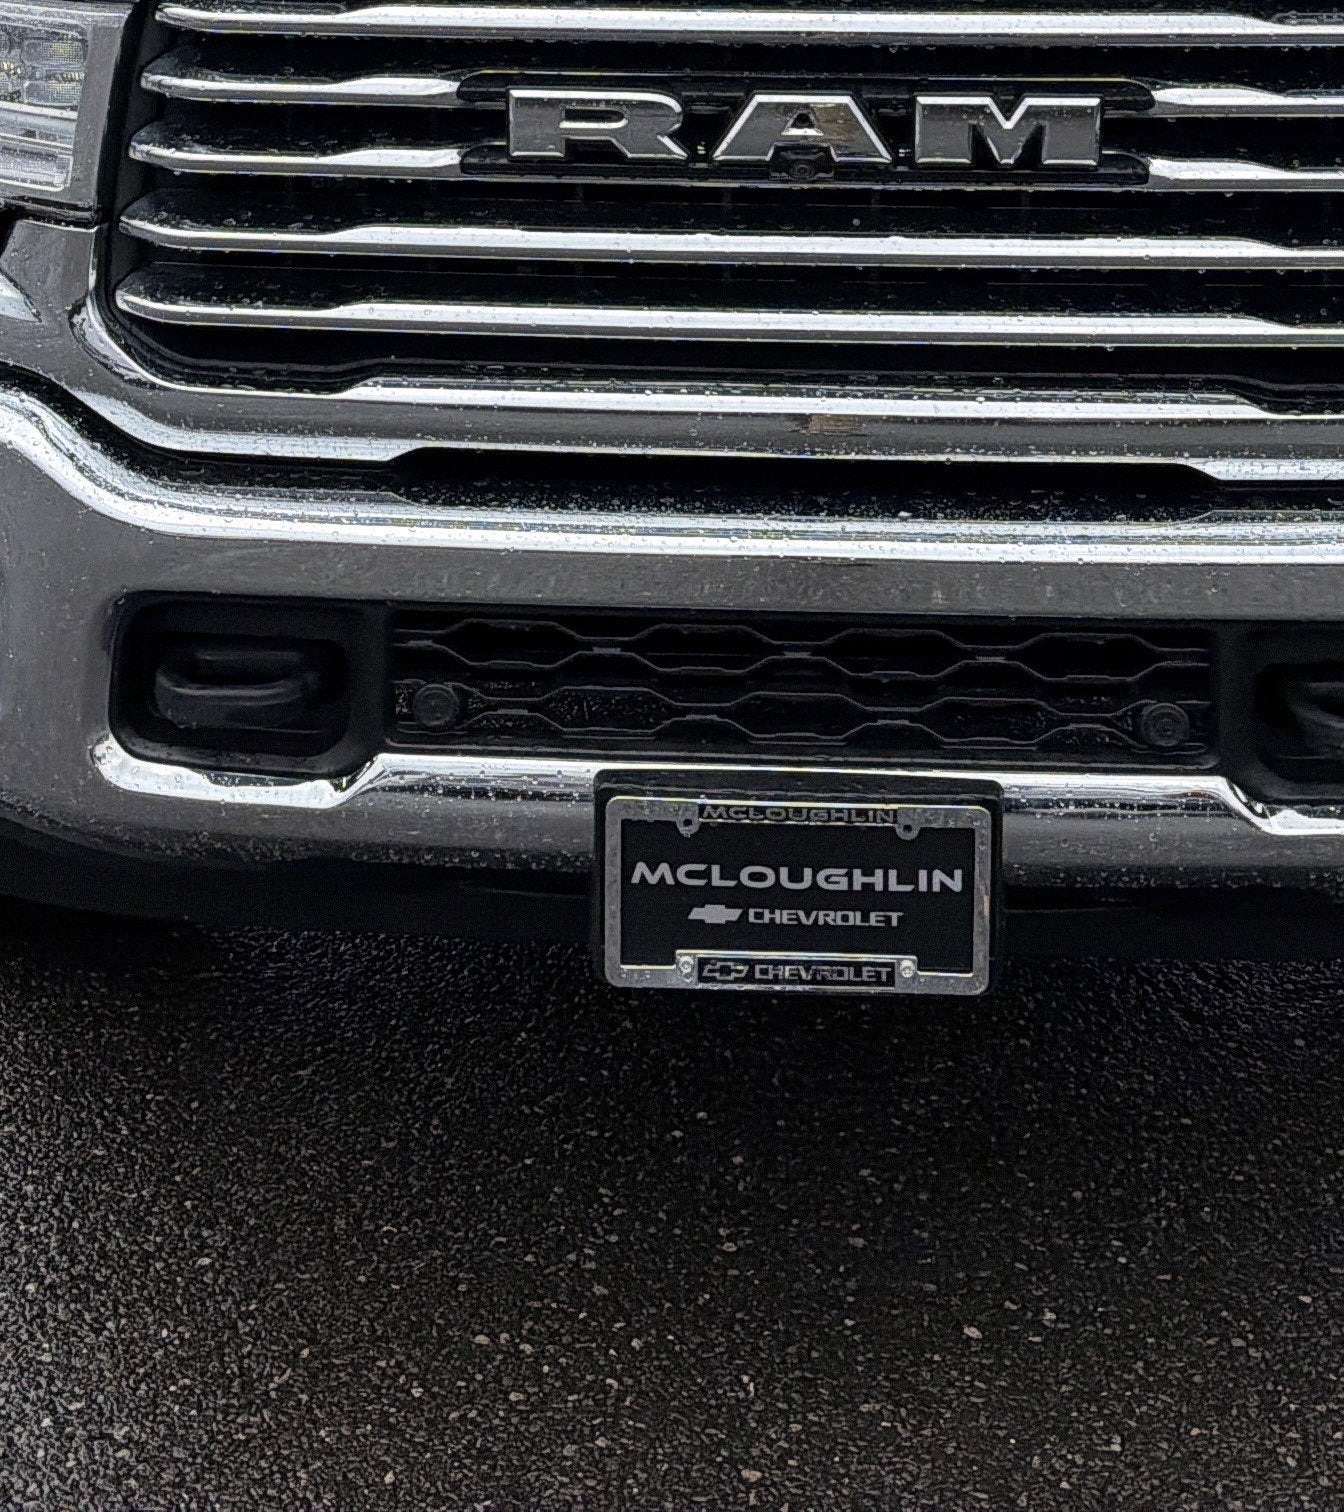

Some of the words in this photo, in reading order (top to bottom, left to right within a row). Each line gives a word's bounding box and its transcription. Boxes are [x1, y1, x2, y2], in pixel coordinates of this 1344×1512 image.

[506, 89, 1103, 167] RAM
[702, 805, 895, 823] MCLOUGHLIN
[630, 861, 963, 893] MCLOUGHLIN
[748, 908, 904, 928] CHEVROLET
[754, 963, 892, 982] CHEVROLET
